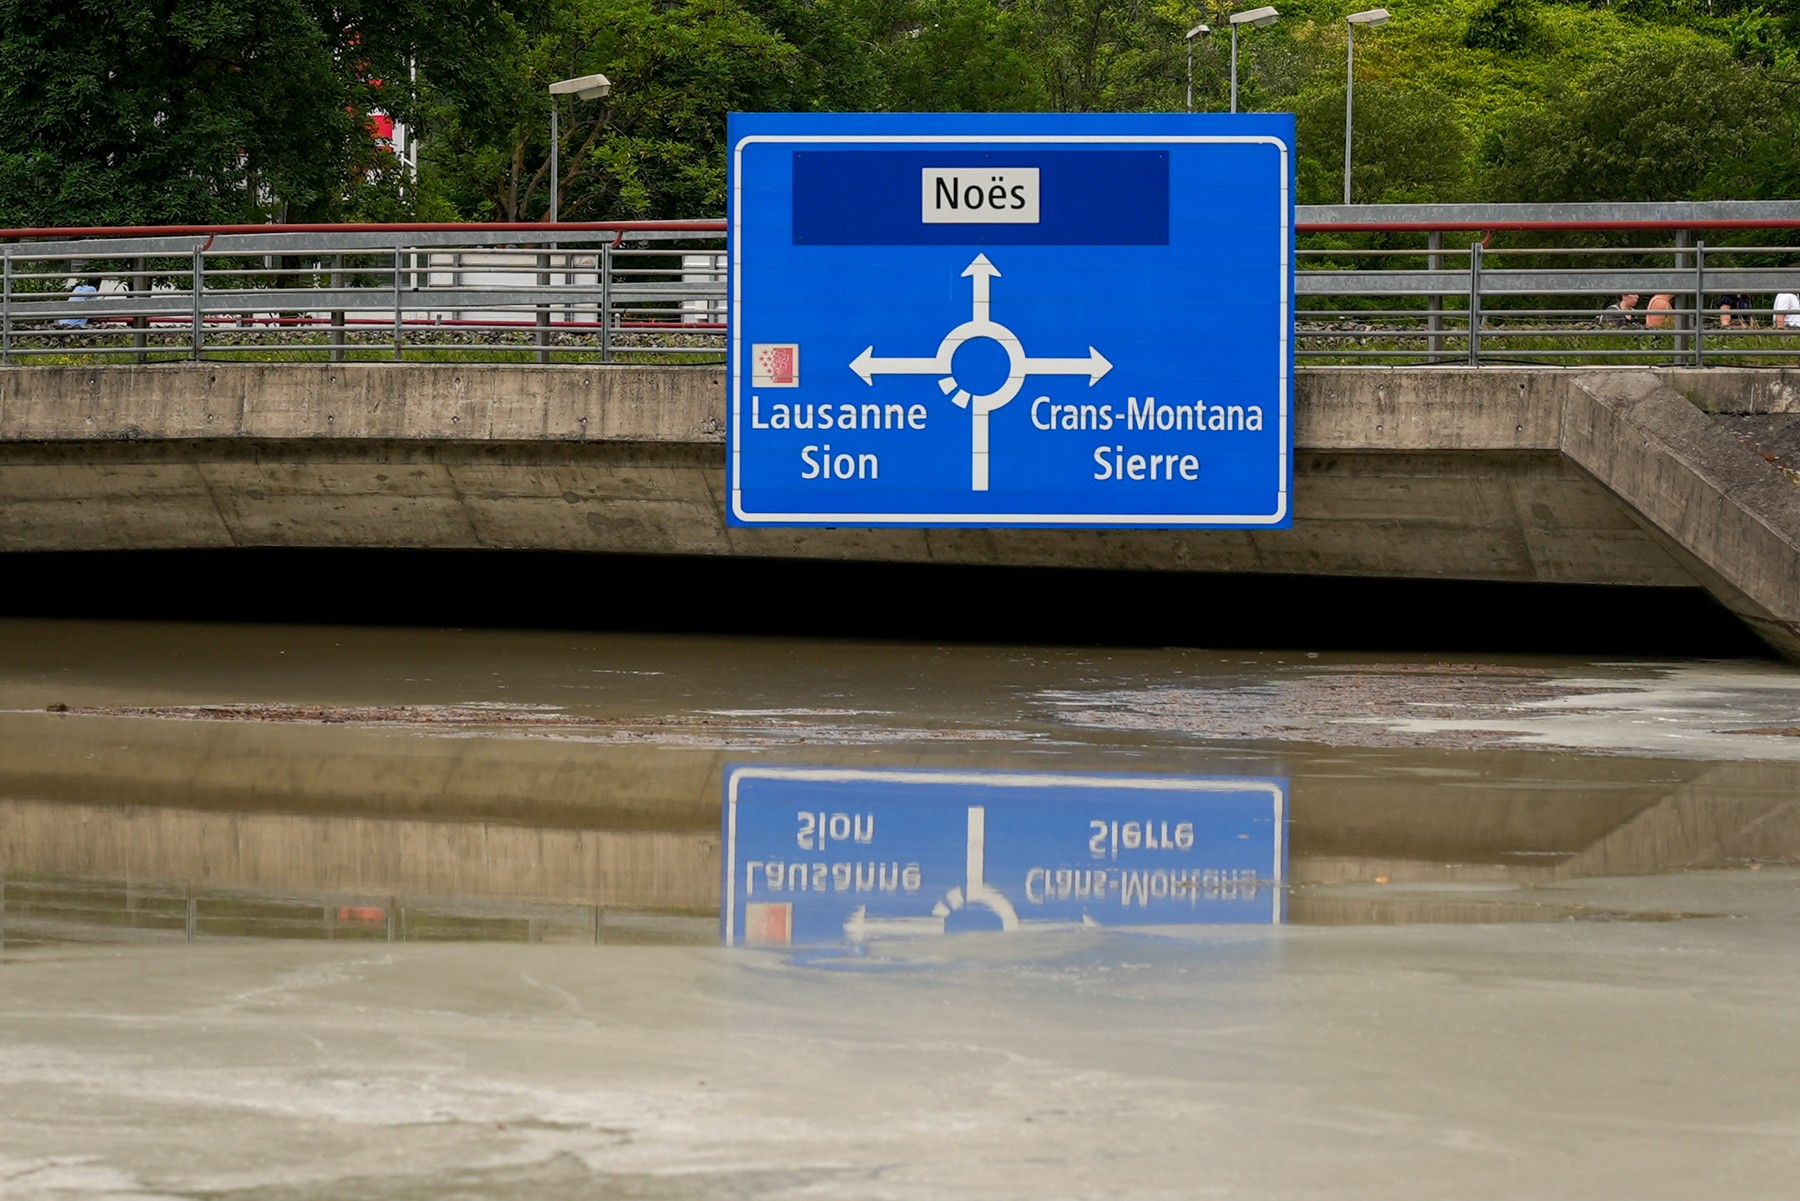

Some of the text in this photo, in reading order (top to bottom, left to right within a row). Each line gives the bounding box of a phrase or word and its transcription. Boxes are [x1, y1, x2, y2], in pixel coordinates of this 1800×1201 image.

[936, 177, 1026, 210] Noës
[752, 396, 927, 430] Lausanne
[1031, 397, 1263, 431] Crans-Montana
[801, 445, 878, 480] Sion
[1093, 446, 1199, 481] Sierre
